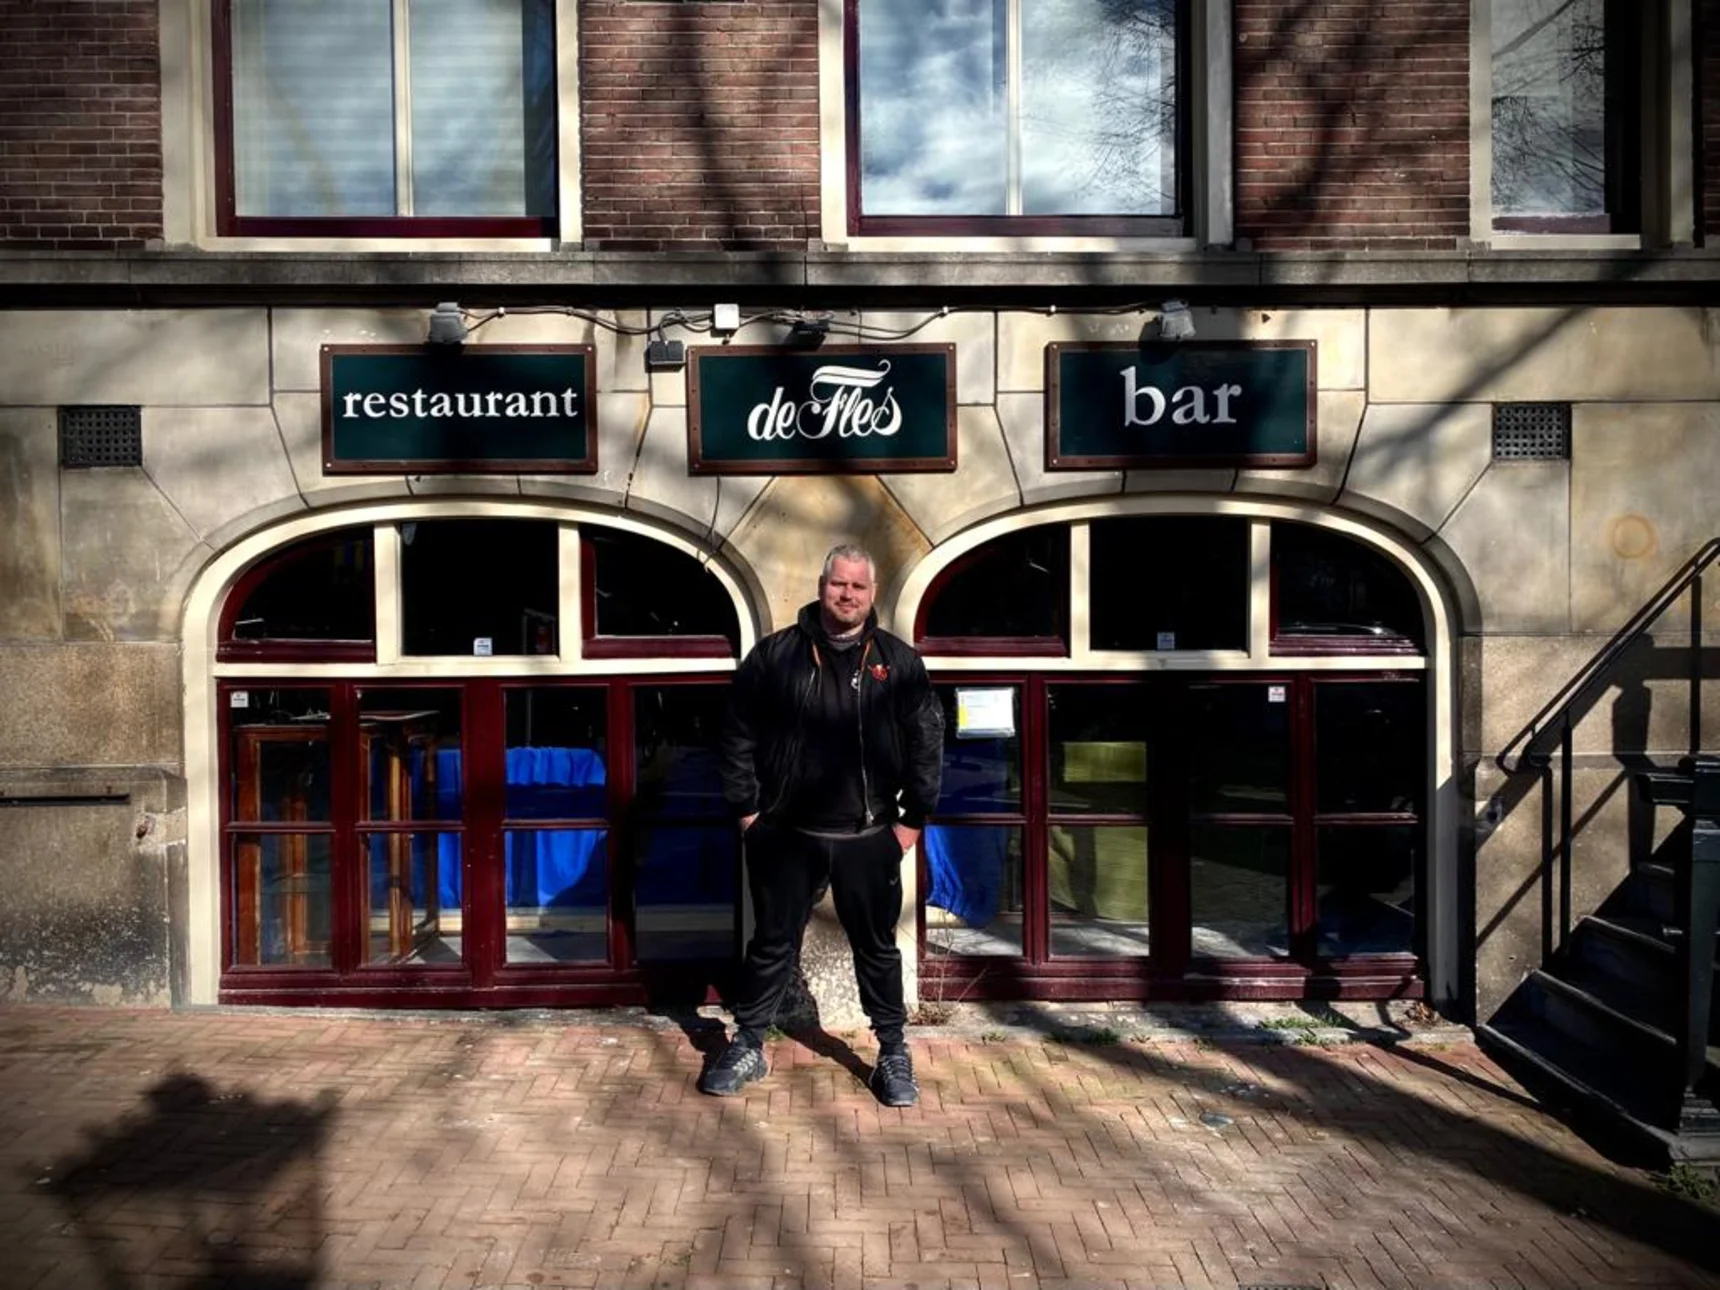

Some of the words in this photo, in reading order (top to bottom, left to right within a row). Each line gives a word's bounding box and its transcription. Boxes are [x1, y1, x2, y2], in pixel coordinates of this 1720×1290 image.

[342, 386, 578, 419] restaurant
[747, 386, 796, 441] de
[796, 359, 902, 440] Fles
[1119, 365, 1243, 427] bar
